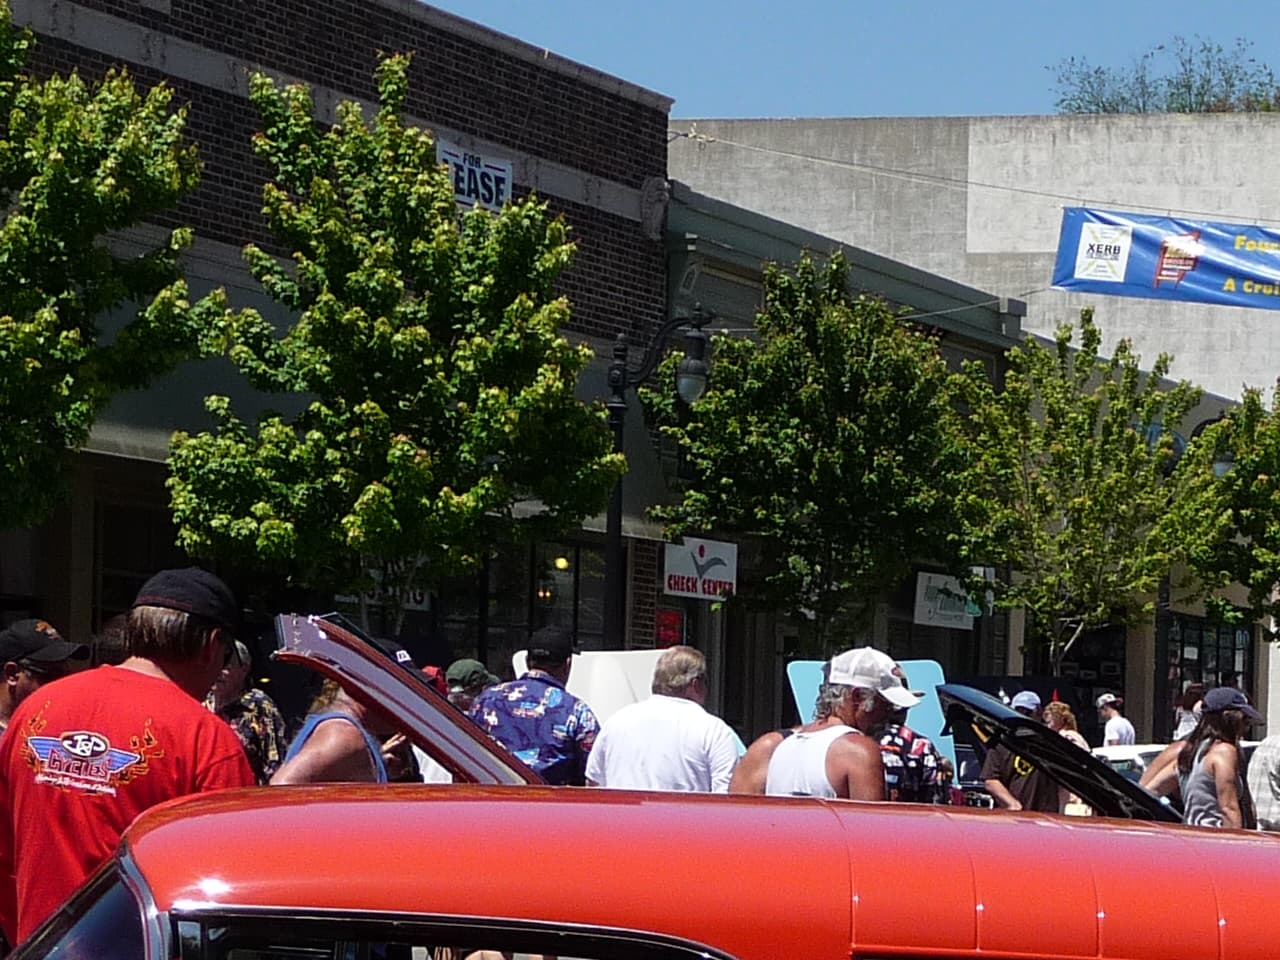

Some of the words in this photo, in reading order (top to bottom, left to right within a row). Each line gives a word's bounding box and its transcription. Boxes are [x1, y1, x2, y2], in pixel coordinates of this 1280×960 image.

[463, 152, 481, 168] FOR
[443, 158, 506, 207] EASE
[1087, 243, 1121, 255] XERB
[1223, 278, 1236, 292] A
[667, 574, 697, 592] CHECK
[47, 748, 113, 781] CYCLES
